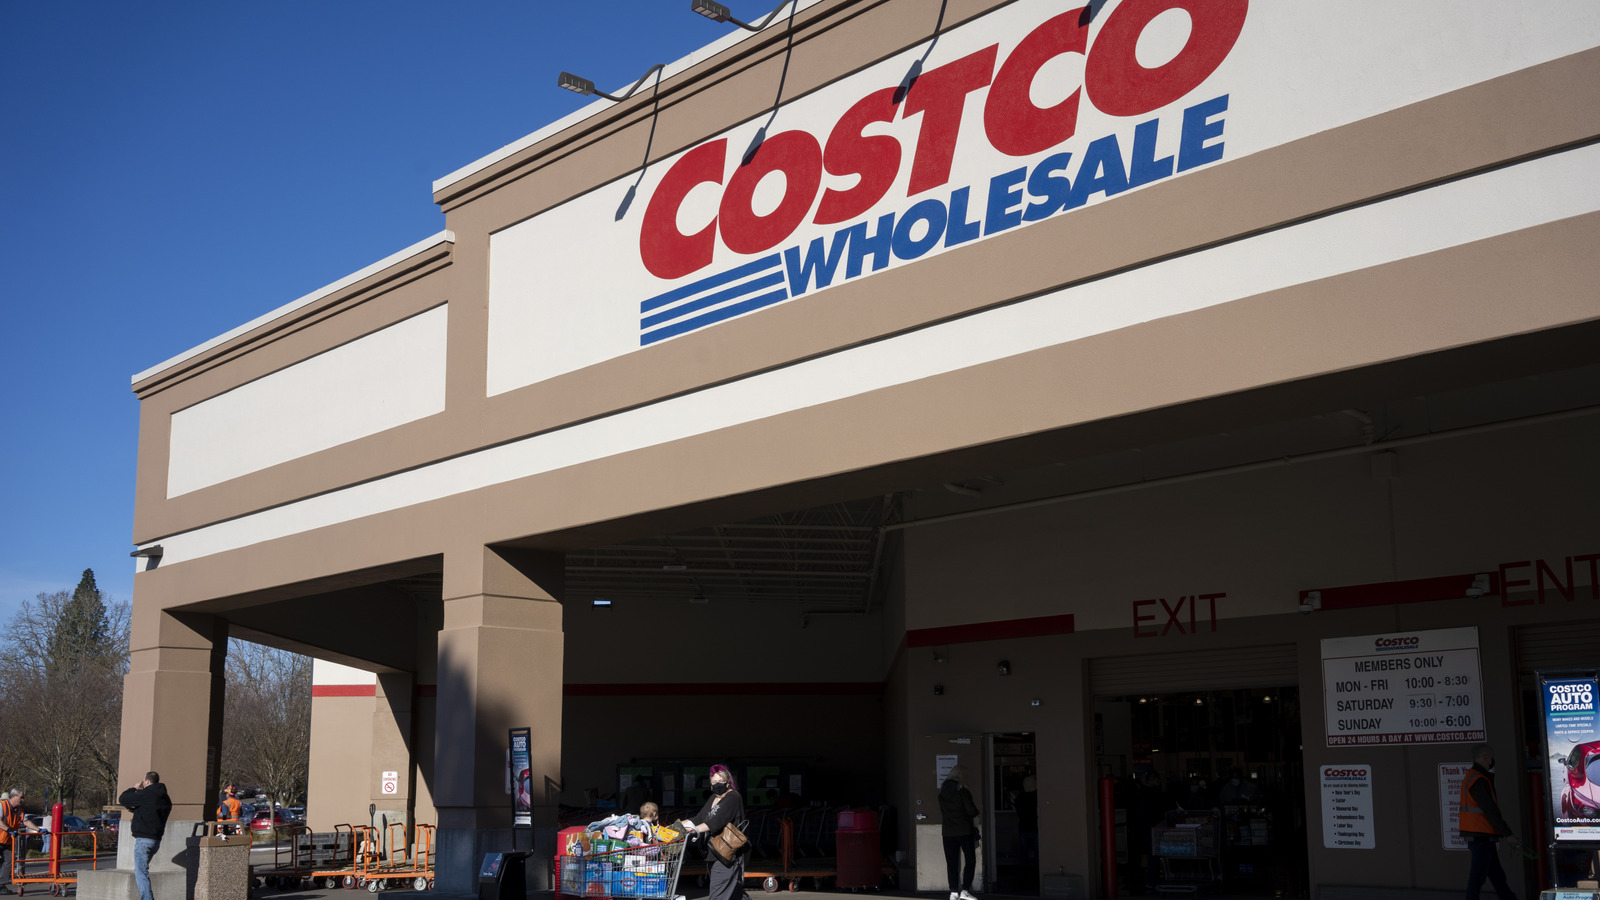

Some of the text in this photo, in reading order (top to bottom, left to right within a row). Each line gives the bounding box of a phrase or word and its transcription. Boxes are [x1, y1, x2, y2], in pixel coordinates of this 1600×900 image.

[640, 0, 1249, 280] COSTCO
[782, 94, 1230, 297] WHOLESALE
[1133, 592, 1226, 638] EXIT
[1375, 637, 1419, 647] COSTCO
[1355, 656, 1444, 673] MEMBERS ONLY
[1336, 681, 1361, 693] MON
[1371, 679, 1389, 691] FRI
[1405, 676, 1434, 689] 10:00
[1444, 675, 1468, 686] 8:30
[1550, 684, 1592, 693] COSTCO
[1337, 698, 1394, 712] SATURDAY
[1409, 698, 1432, 709] 9:30
[1445, 694, 1470, 707] 7:00
[1551, 691, 1593, 705] AUTO
[1550, 703, 1593, 711] PROGRAM
[1338, 718, 1382, 731] SUNDAY
[1409, 718, 1435, 728] 10:00
[1445, 715, 1471, 727] 6:00
[1329, 731, 1484, 745] OPEN 24 HOURS A DAY AT WWW.COSTCO.COM
[1324, 767, 1367, 777] COSTCO
[1441, 766, 1460, 776] Thank
